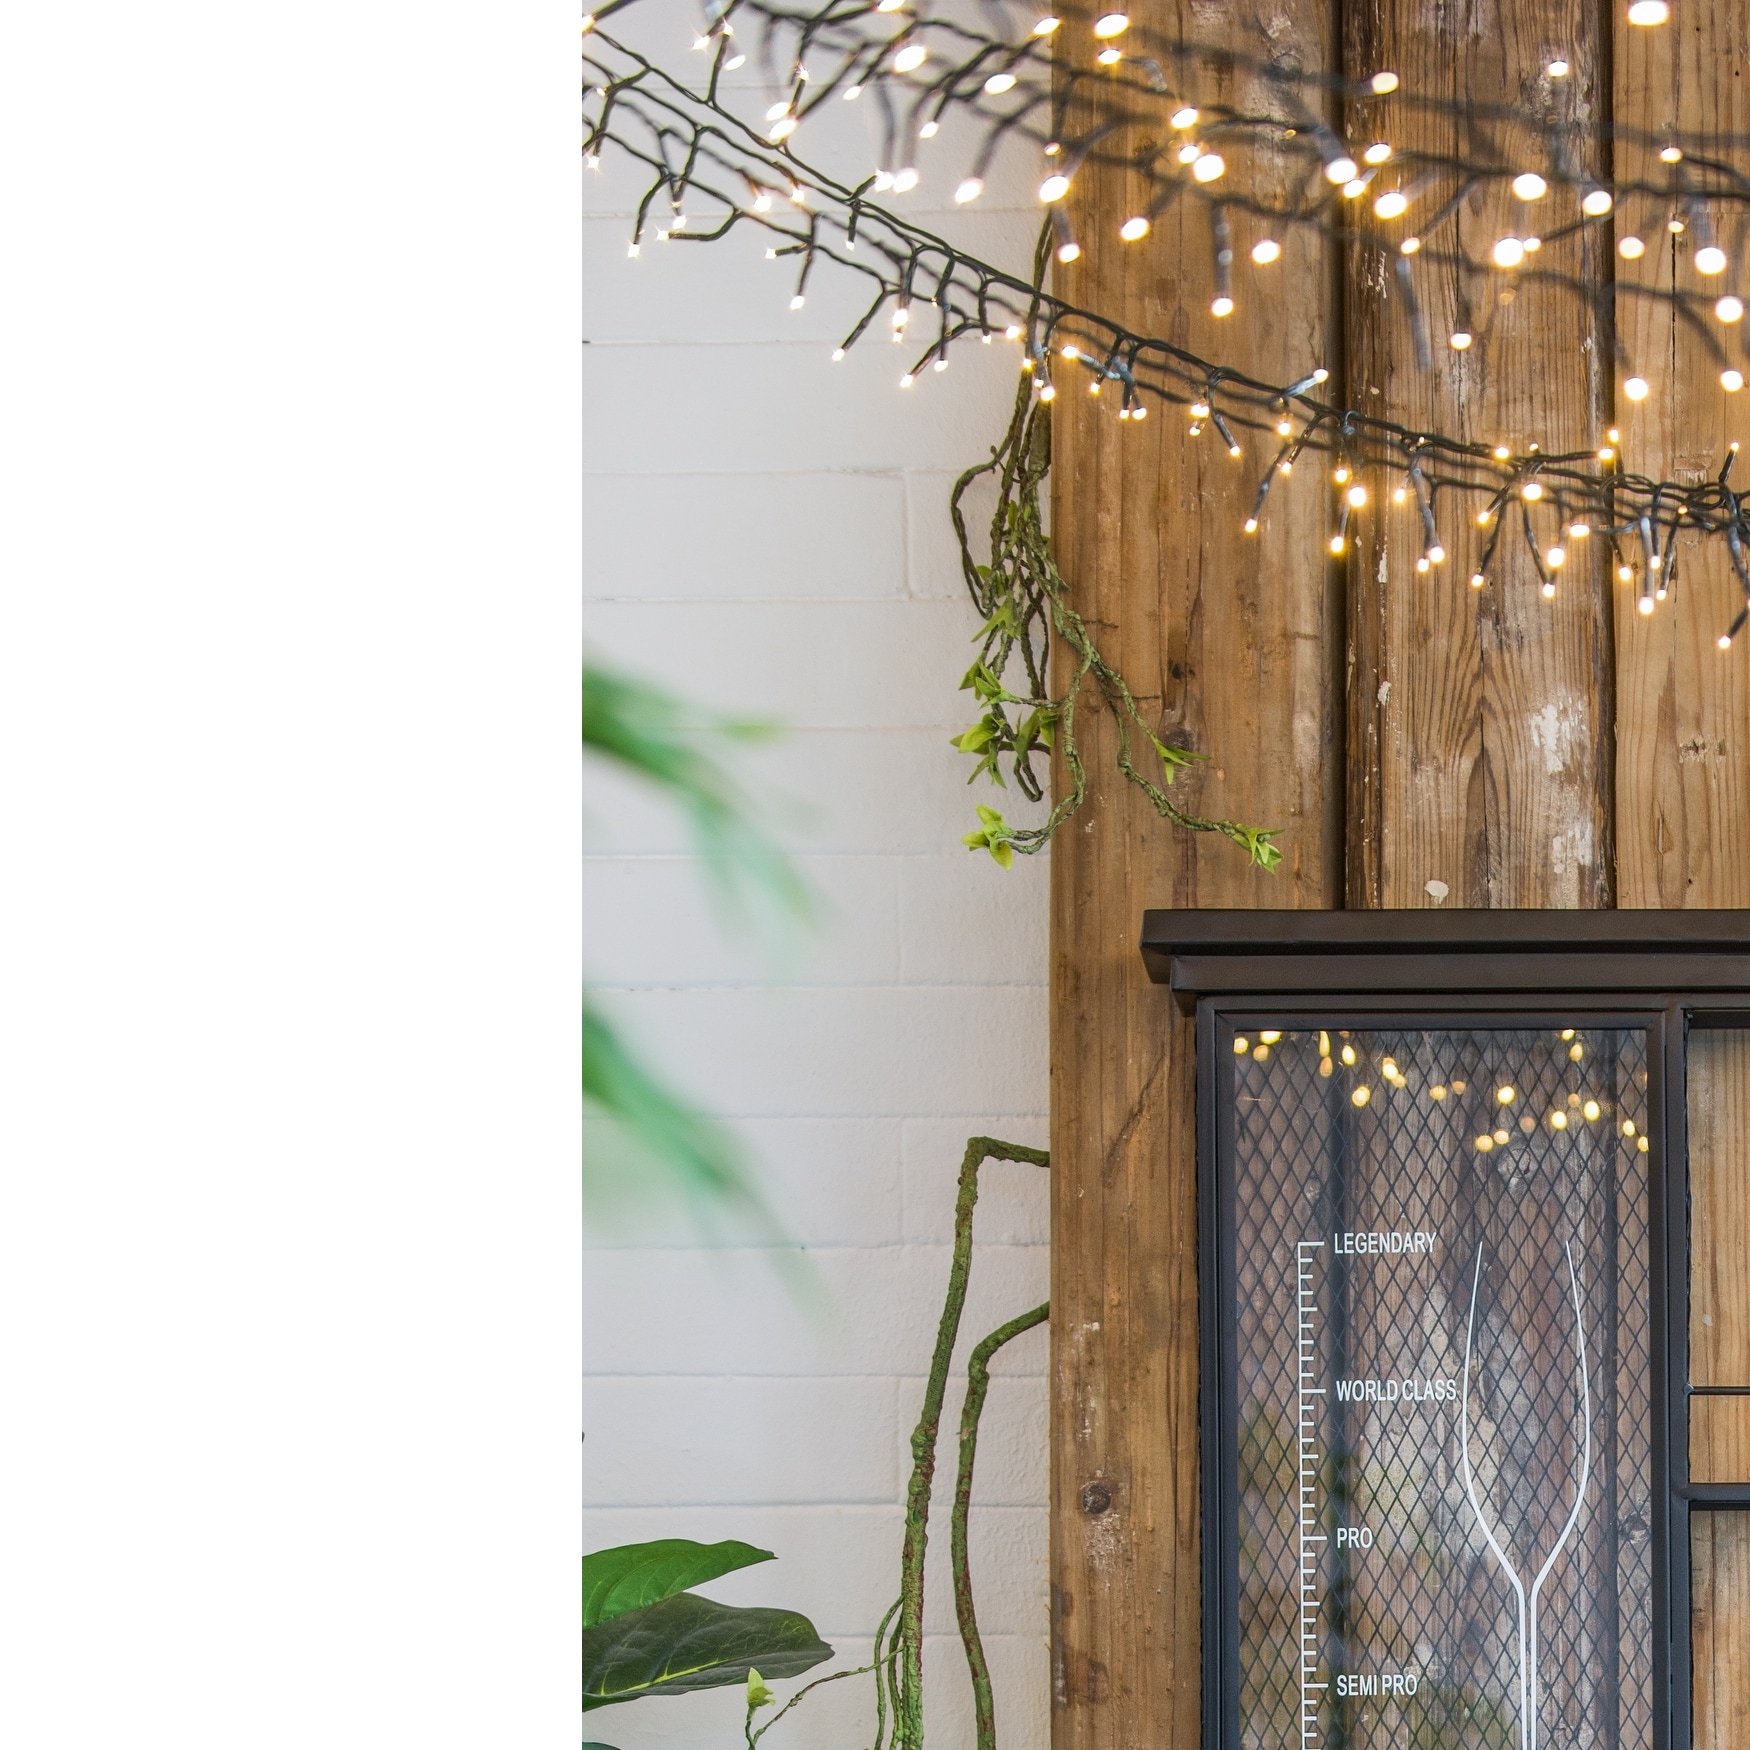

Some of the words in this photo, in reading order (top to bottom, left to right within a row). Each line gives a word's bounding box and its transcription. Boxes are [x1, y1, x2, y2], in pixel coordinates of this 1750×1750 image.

[1334, 1232, 1437, 1254] LEGENDARY
[1336, 1379, 1398, 1402] WORLD
[1402, 1379, 1457, 1401] CLASS
[1336, 1527, 1373, 1549] PRO
[1336, 1674, 1377, 1697] SEMI
[1382, 1674, 1418, 1696] PRO
